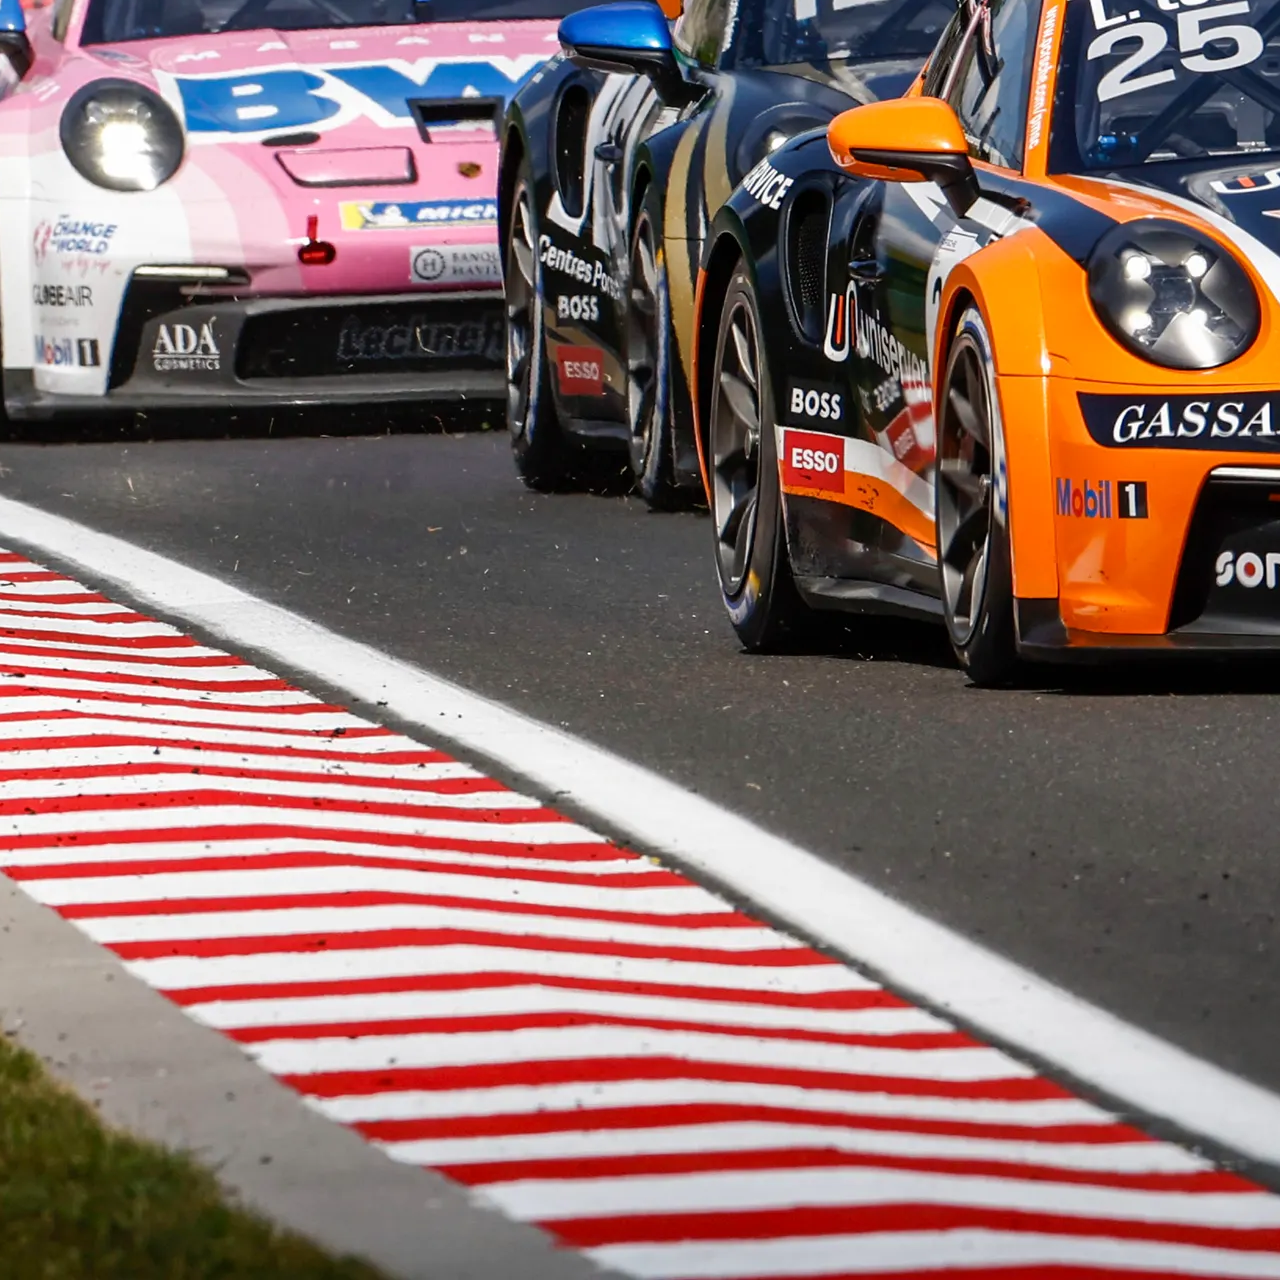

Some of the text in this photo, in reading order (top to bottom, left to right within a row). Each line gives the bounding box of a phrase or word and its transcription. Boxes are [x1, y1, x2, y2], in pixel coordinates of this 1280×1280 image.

[1086, 0, 1264, 103] 25
[539, 234, 593, 284] Centres
[558, 294, 600, 321] BOSS
[34, 335, 73, 365] Mobil
[154, 323, 219, 356] ADA
[154, 357, 220, 370] COSMETICS
[564, 360, 600, 381] ESSO
[791, 387, 841, 420] BOSS
[791, 446, 839, 474] ESSO
[1056, 477, 1112, 519] Mobil
